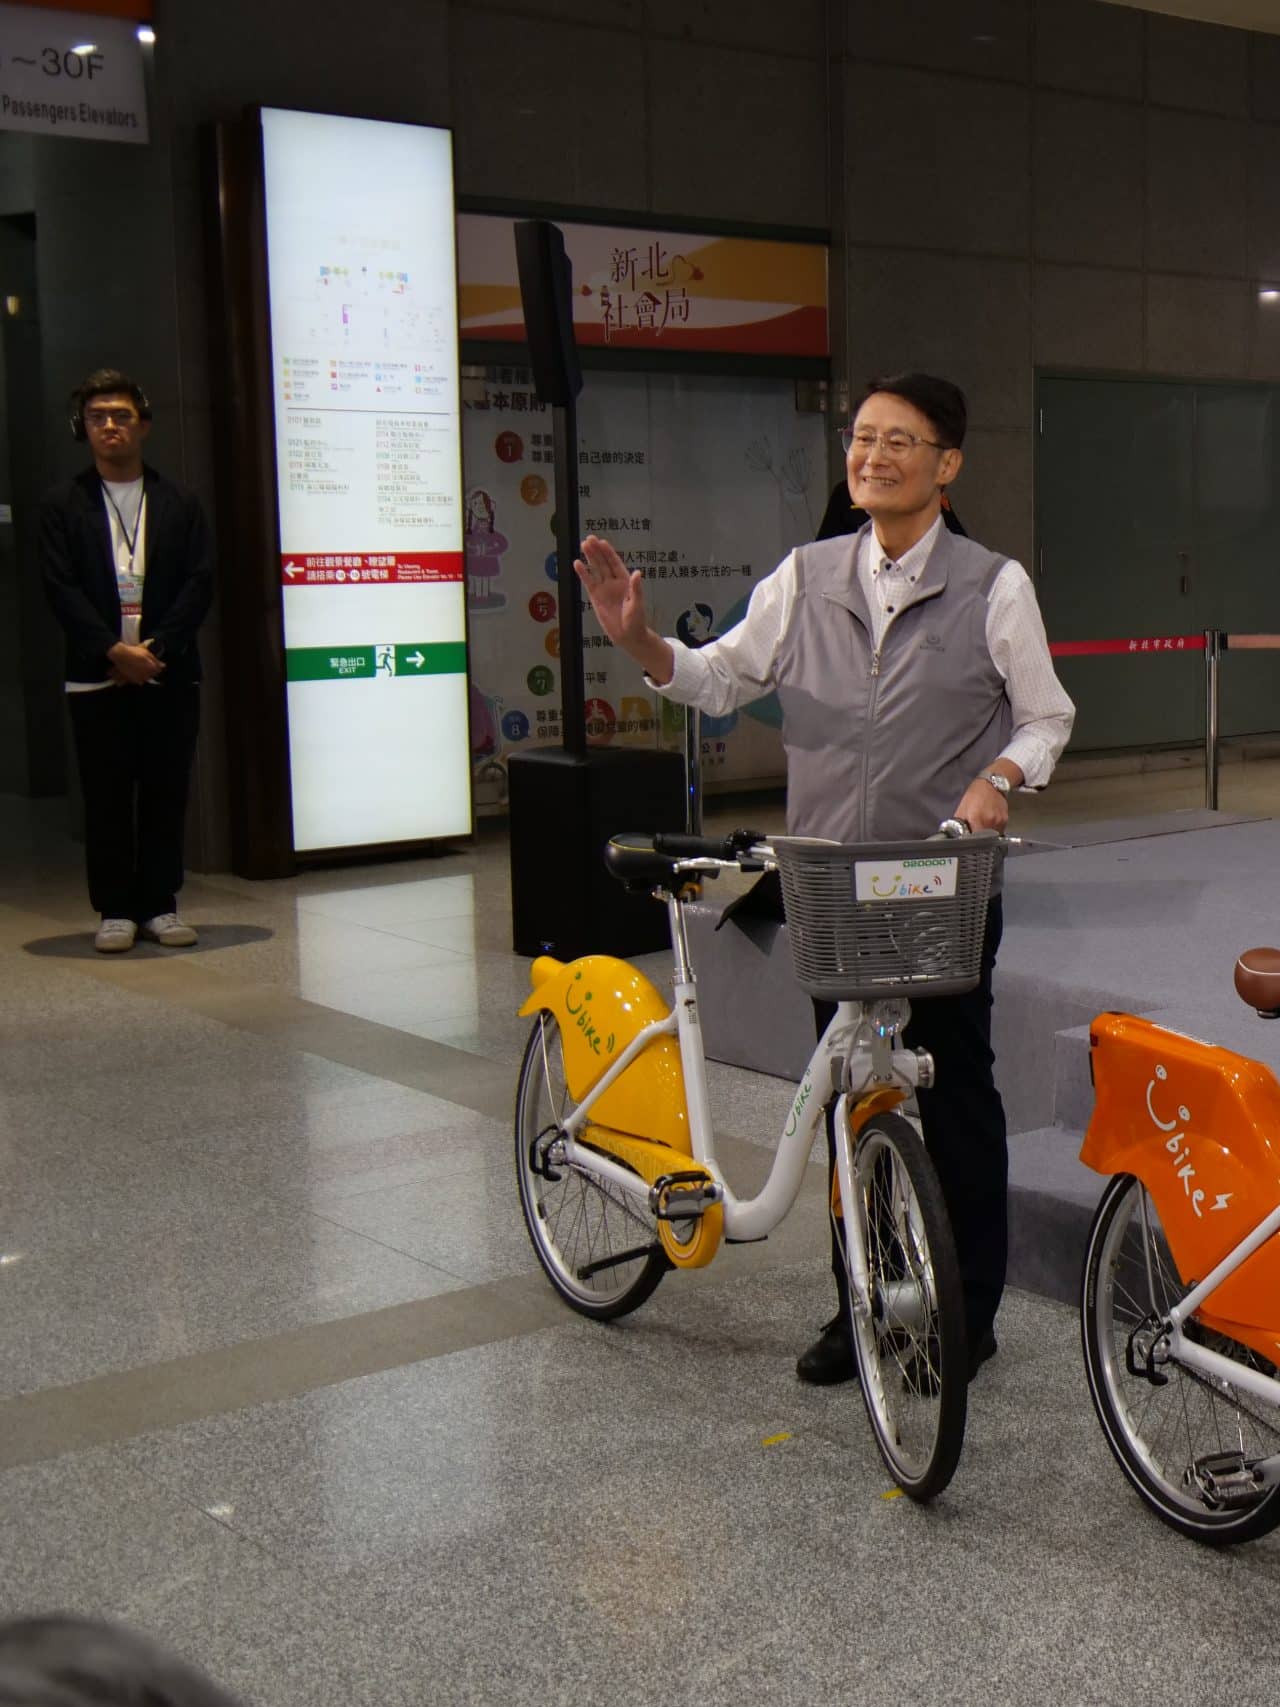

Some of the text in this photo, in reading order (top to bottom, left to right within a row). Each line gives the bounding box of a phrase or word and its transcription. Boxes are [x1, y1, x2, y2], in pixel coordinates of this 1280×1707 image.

[1, 95, 138, 128] Passengers Elevators
[608, 241, 669, 291] 新北
[602, 287, 691, 343] 社會局
[585, 518, 652, 532] 充分融入社會
